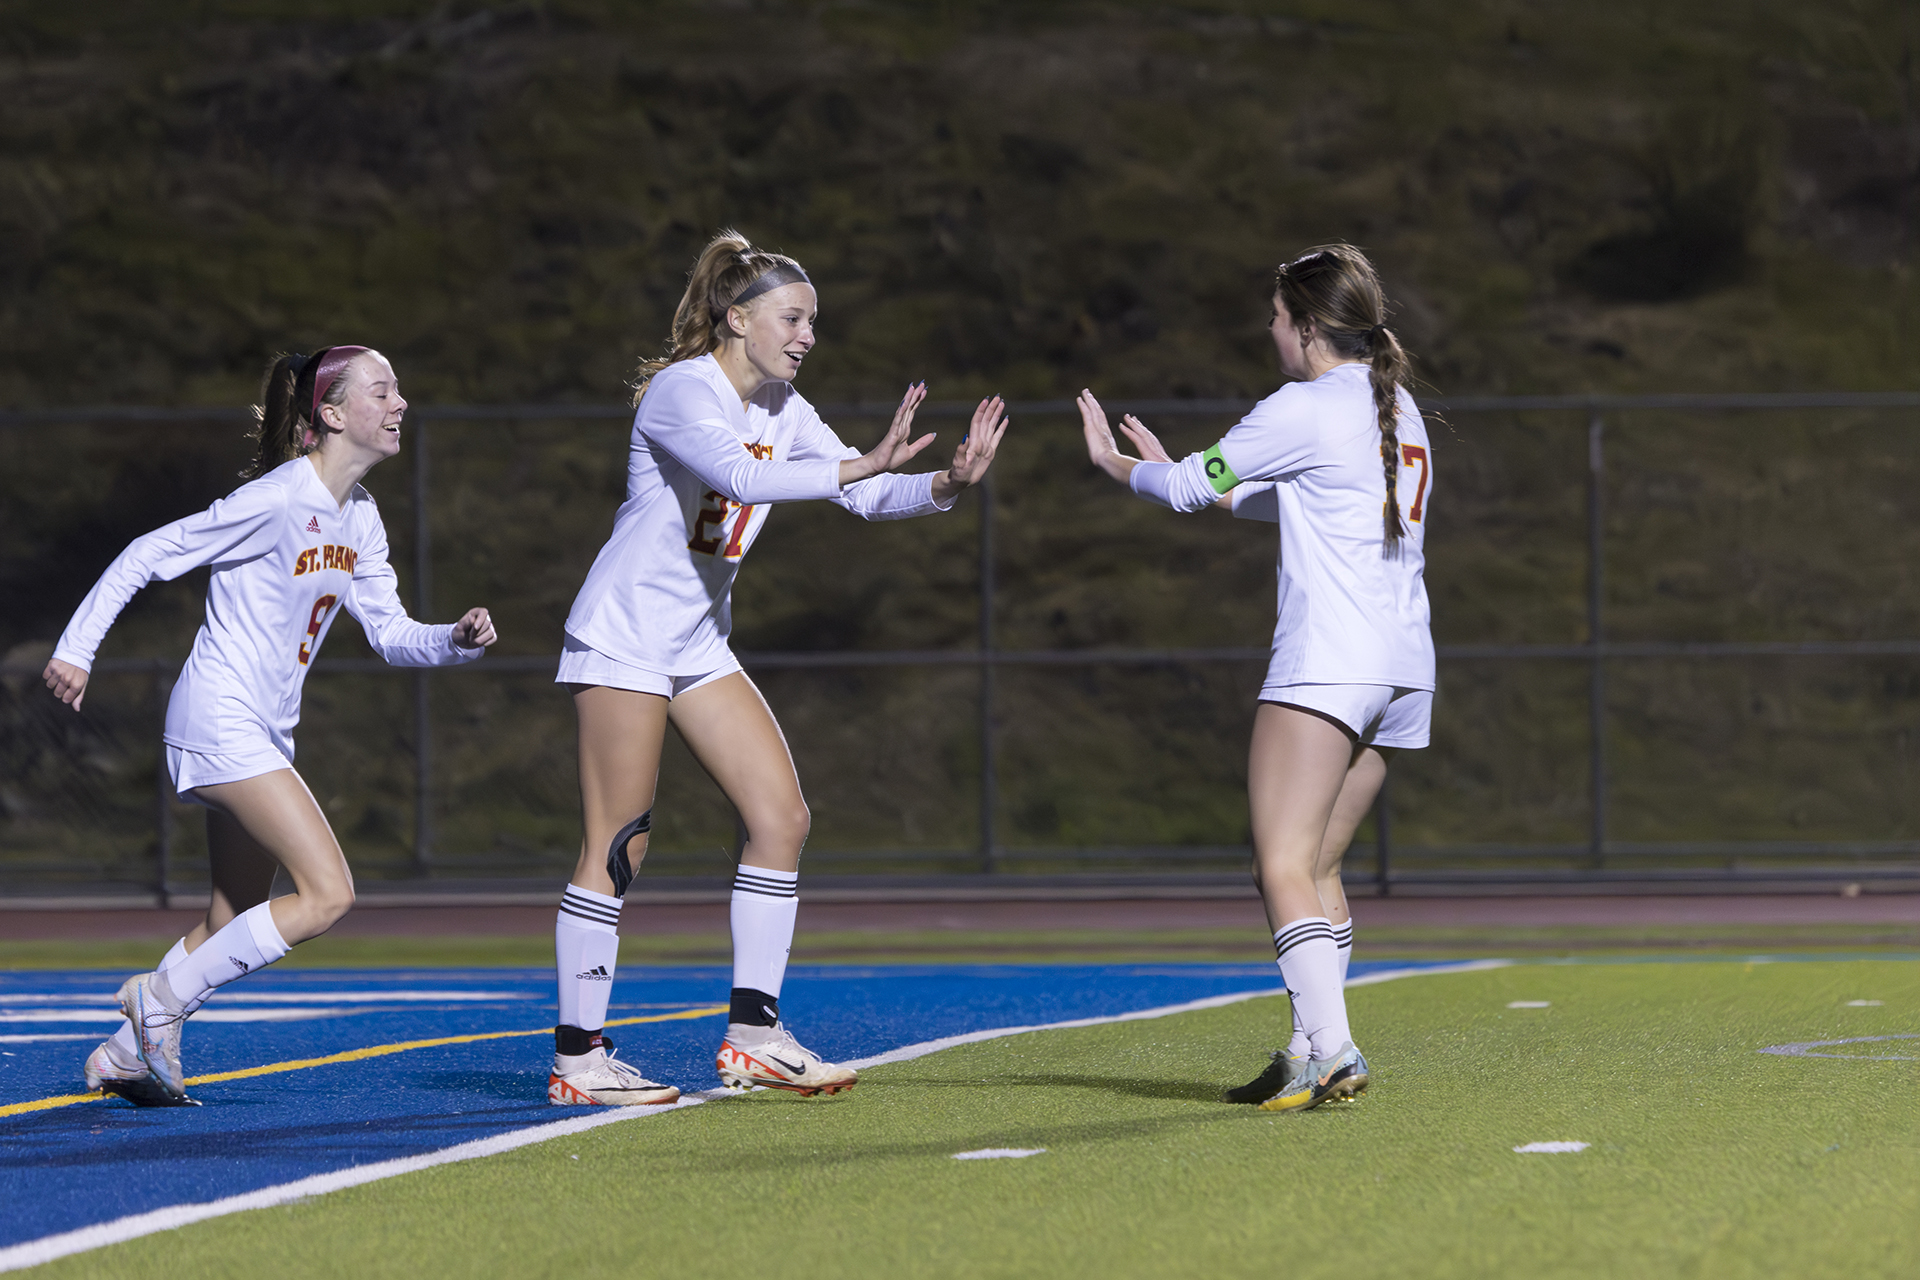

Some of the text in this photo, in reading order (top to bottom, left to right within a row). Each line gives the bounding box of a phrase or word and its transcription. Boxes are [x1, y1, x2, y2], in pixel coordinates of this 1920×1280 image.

[1205, 457, 1225, 479] C
[686, 490, 754, 558] 21
[293, 547, 320, 577] ST.
[576, 973, 612, 981] adidas
